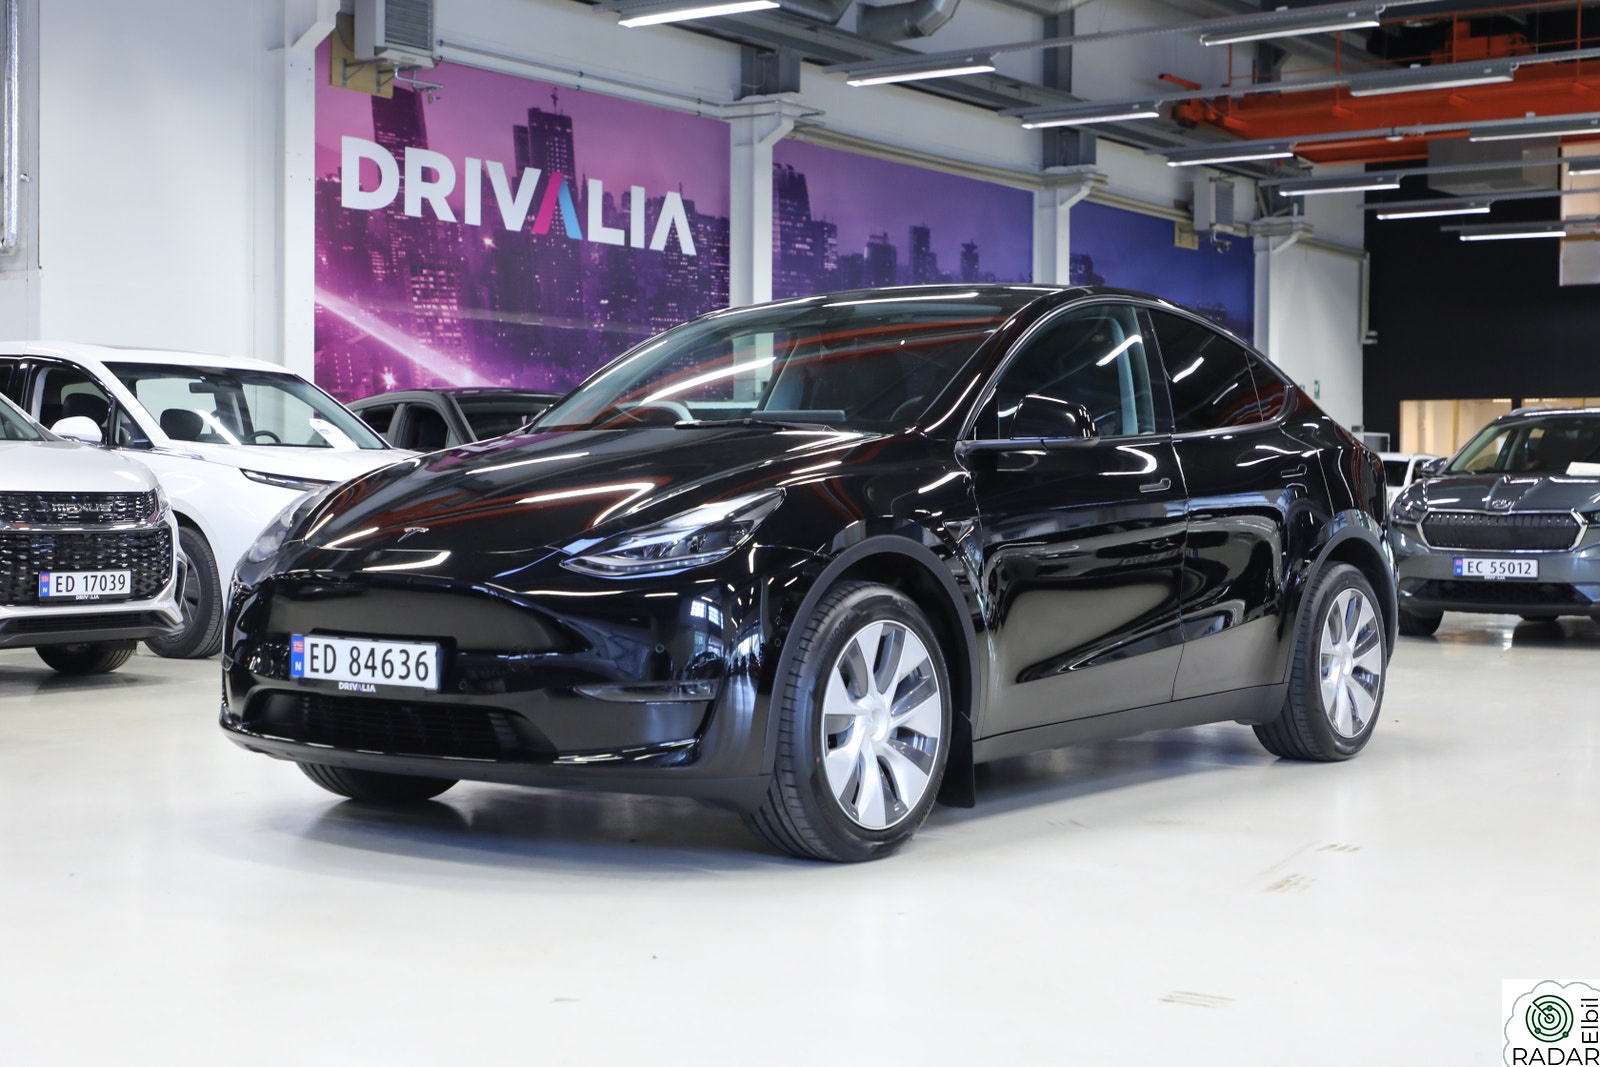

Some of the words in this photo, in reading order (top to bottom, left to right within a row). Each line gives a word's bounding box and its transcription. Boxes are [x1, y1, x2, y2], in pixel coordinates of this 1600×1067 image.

[341, 135, 697, 256] DRIVALIA
[1467, 561, 1483, 573] EC
[1490, 562, 1531, 574] 55012
[55, 575, 75, 593] ED
[83, 574, 126, 592] 17039
[295, 661, 302, 671] N
[310, 643, 337, 673] ED
[349, 646, 428, 681] 84636
[338, 682, 376, 693] DRIVALIA
